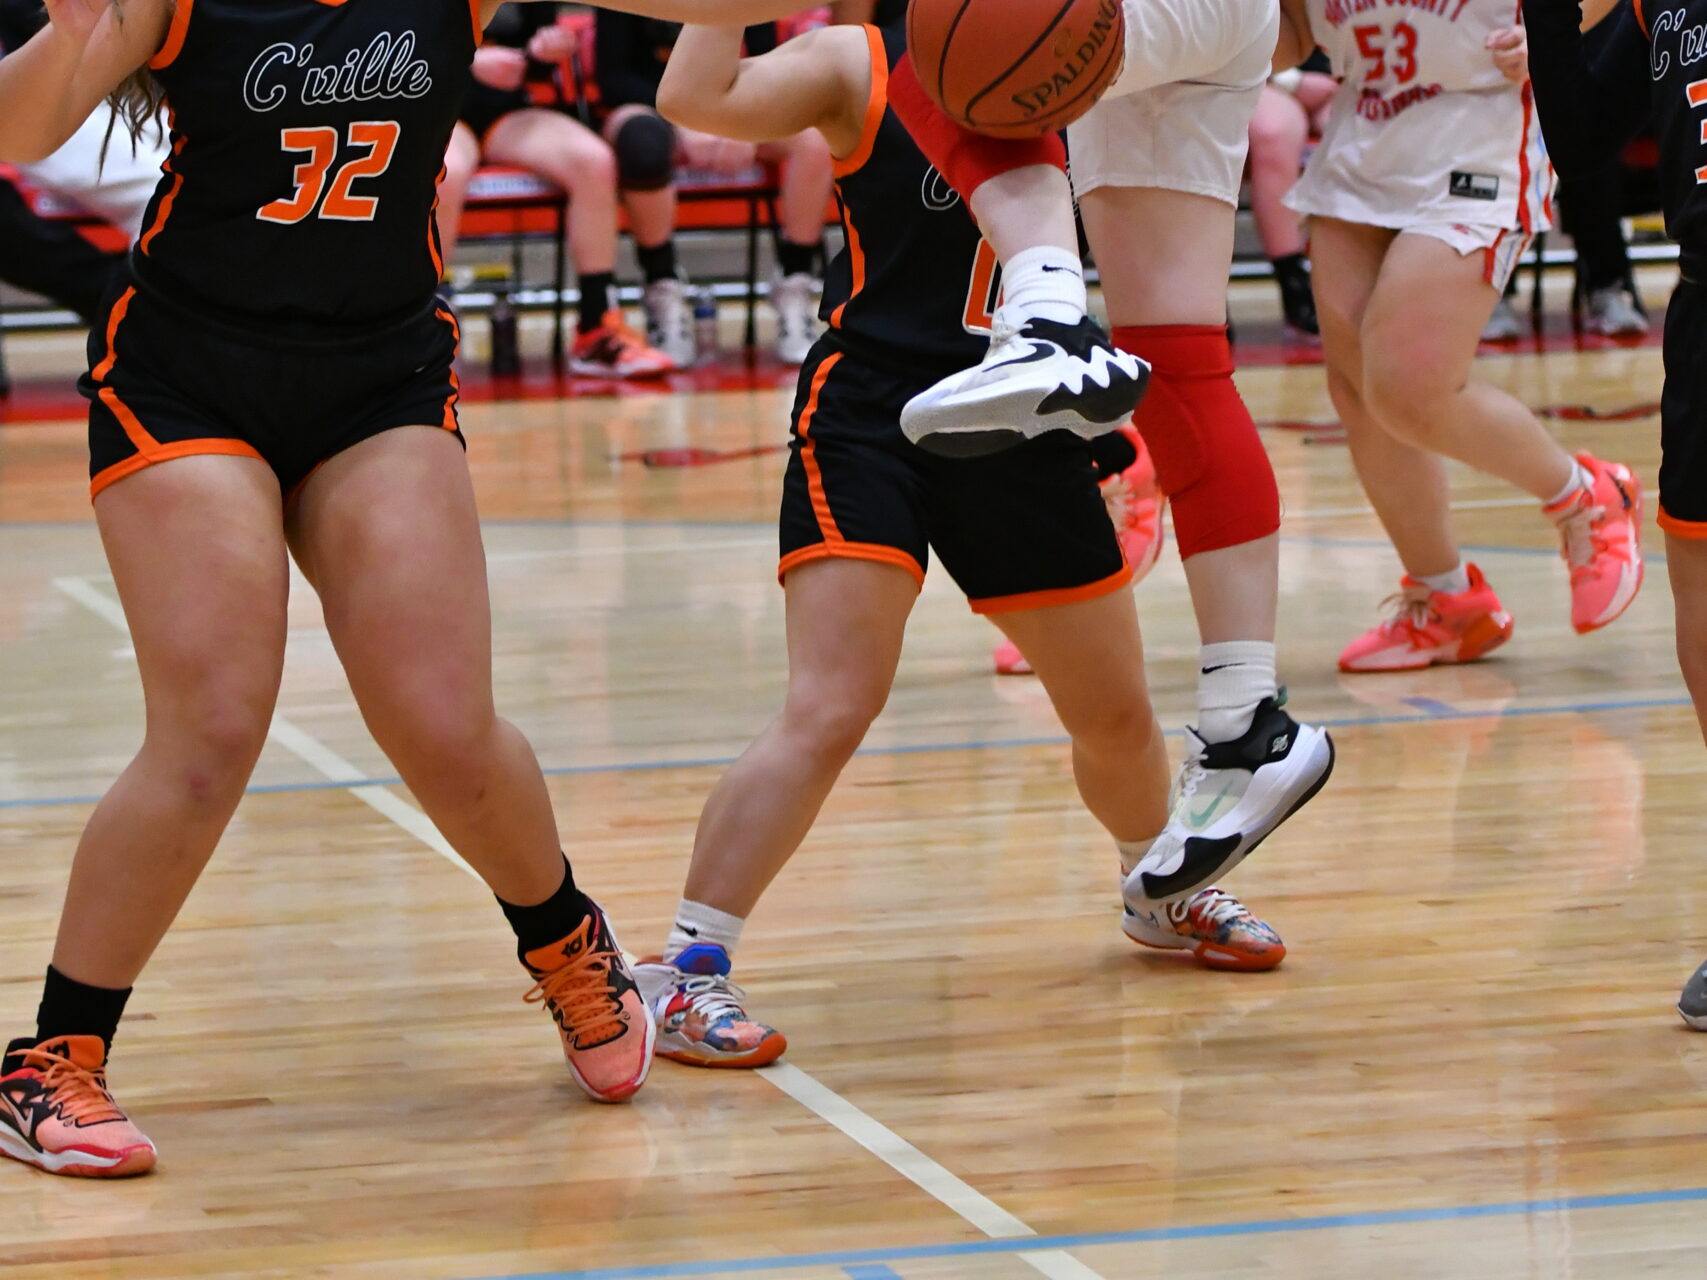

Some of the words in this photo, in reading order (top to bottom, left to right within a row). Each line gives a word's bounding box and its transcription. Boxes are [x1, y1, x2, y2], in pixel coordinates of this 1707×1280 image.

[243, 29, 433, 113] C'ville
[1353, 20, 1418, 83] 53
[255, 120, 401, 225] 32
